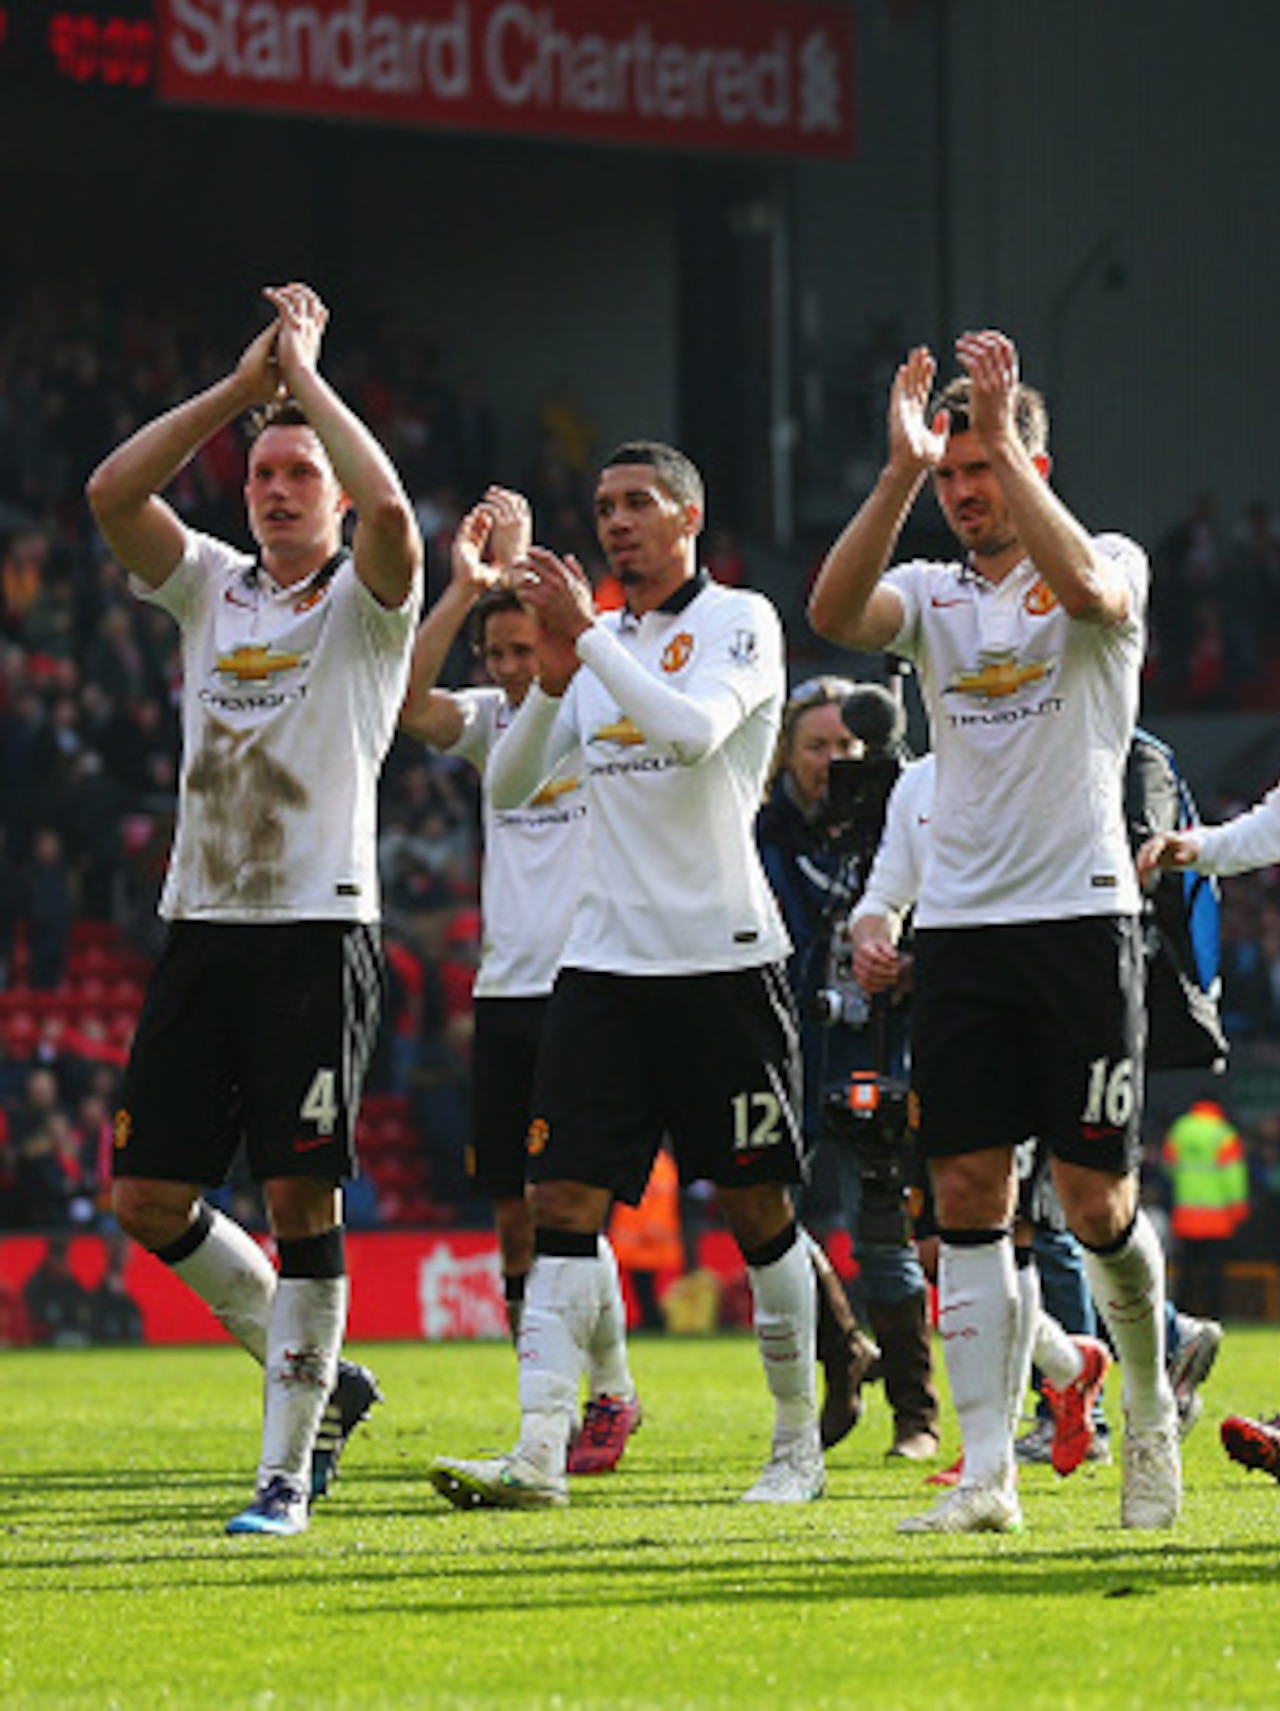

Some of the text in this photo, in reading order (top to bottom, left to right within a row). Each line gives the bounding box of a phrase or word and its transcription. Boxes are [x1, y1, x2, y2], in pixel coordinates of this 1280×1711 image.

[486, 2, 791, 126] Chartered
[299, 1066, 339, 1136] 4
[730, 1091, 782, 1149] 12
[1082, 1055, 1135, 1127] 16
